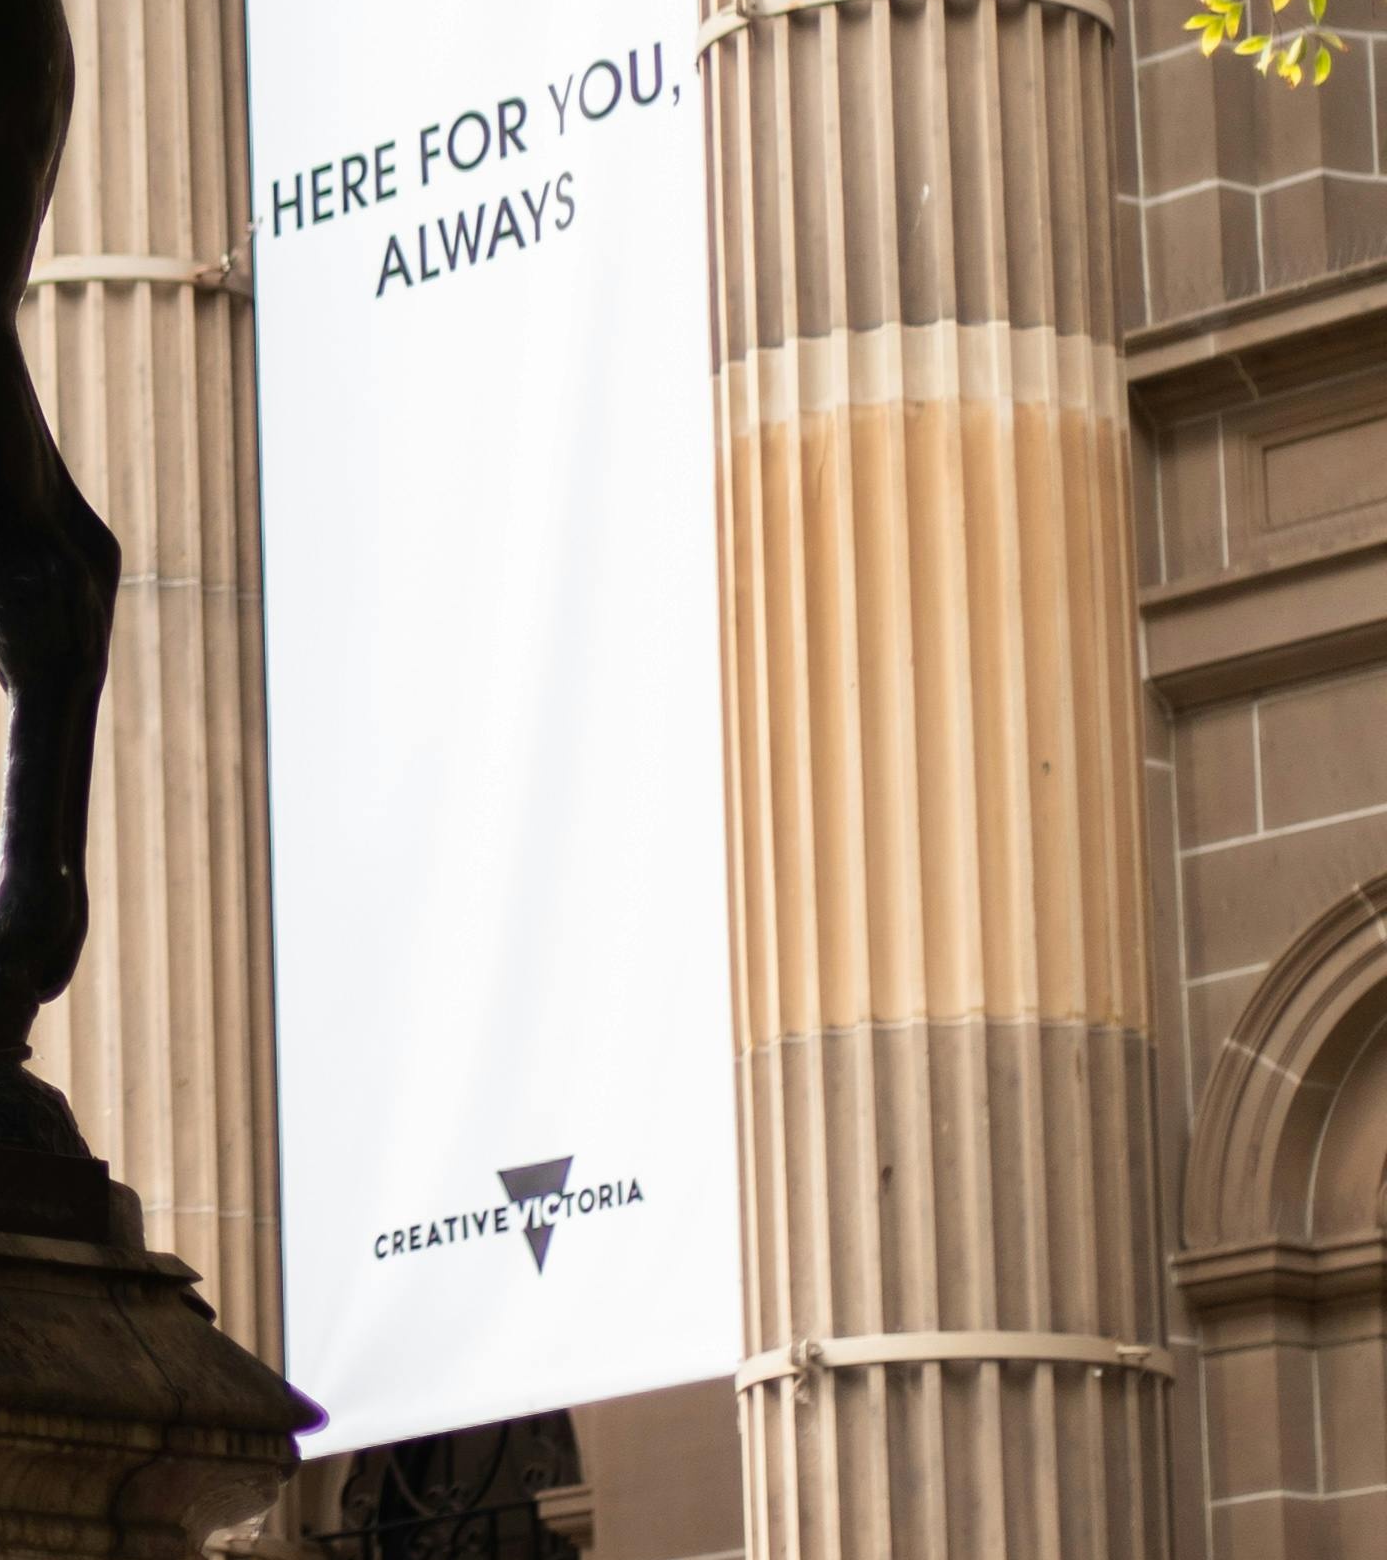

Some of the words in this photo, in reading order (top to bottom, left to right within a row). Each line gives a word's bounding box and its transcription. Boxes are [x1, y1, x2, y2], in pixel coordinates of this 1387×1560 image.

[271, 140, 398, 238] HERE
[419, 96, 529, 187] FOR
[547, 41, 682, 136] YOU,
[375, 170, 576, 299] ALWAYS
[374, 1205, 510, 1260] CREATIVE
[510, 1177, 644, 1230] VICTORIA
